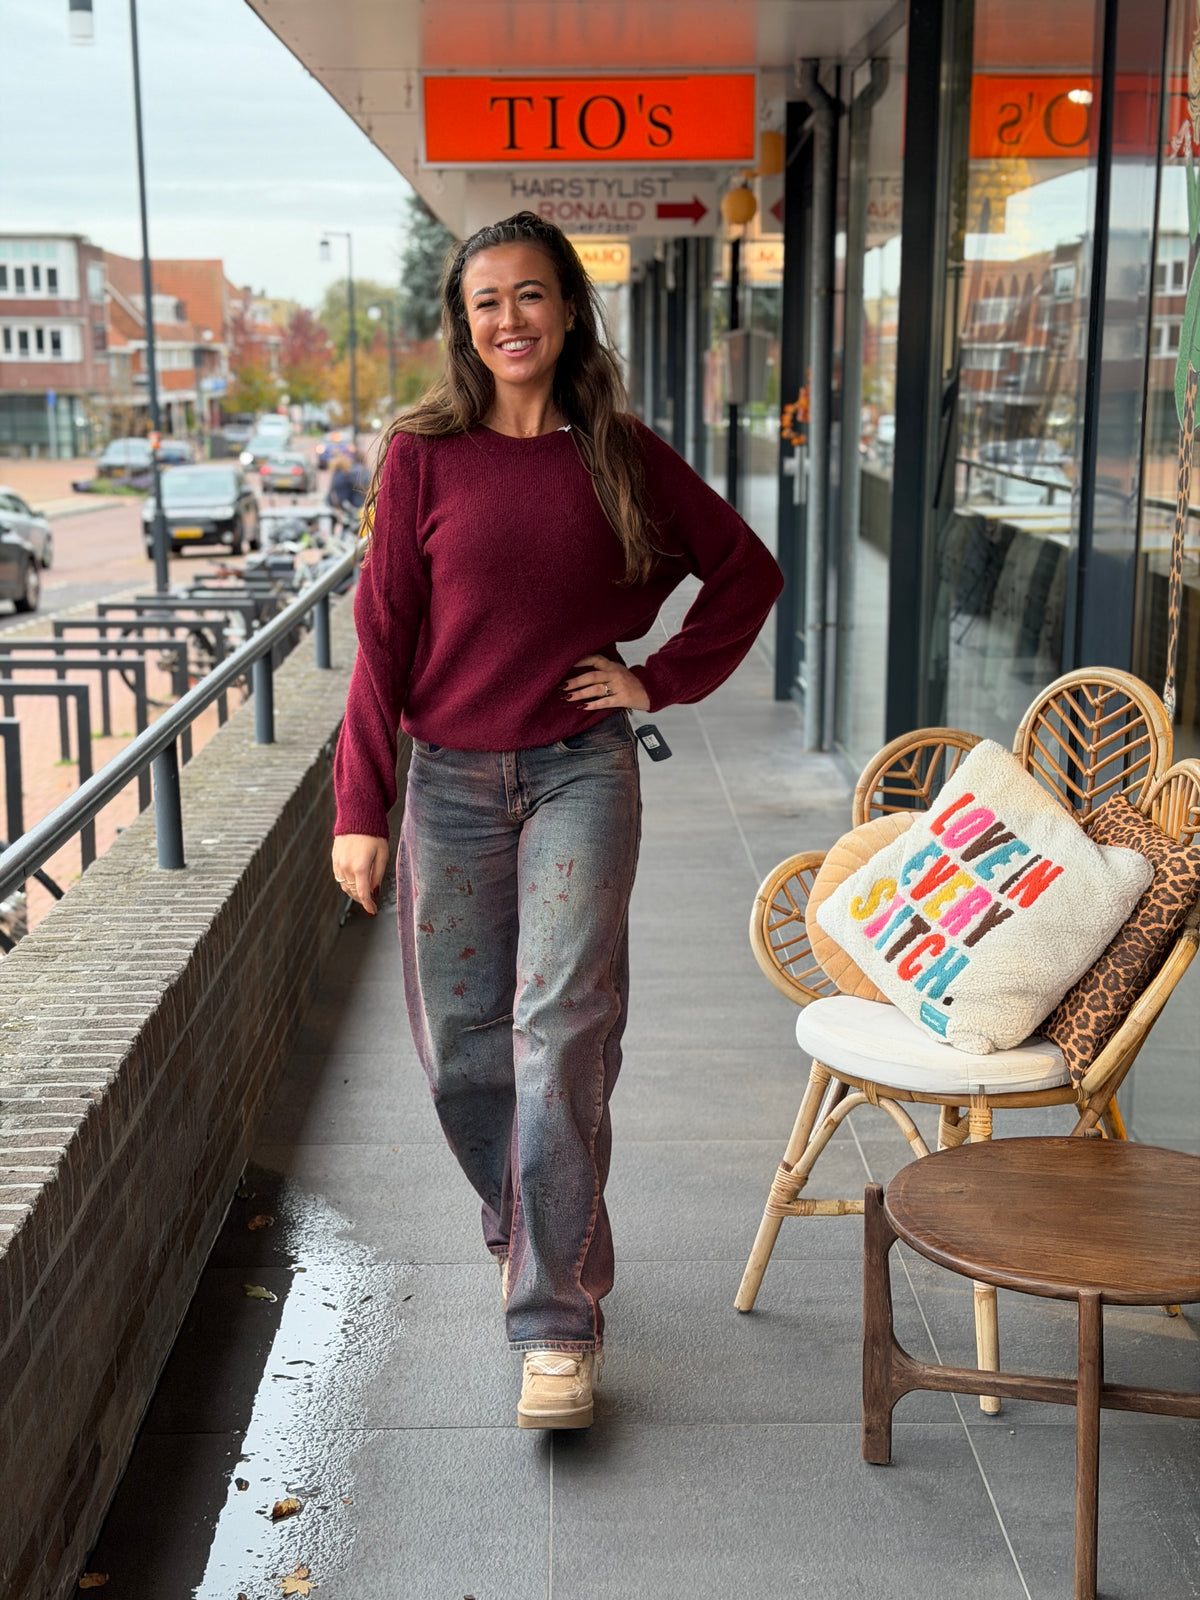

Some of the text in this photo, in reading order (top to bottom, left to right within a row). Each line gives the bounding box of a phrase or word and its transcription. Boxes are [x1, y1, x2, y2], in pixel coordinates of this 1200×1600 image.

[489, 94, 674, 151] TIO's
[510, 177, 673, 198] HAIRSTYLIST
[537, 201, 646, 221] RONALD
[929, 792, 1065, 909] LOVE IN
[900, 841, 1015, 948] EVERY
